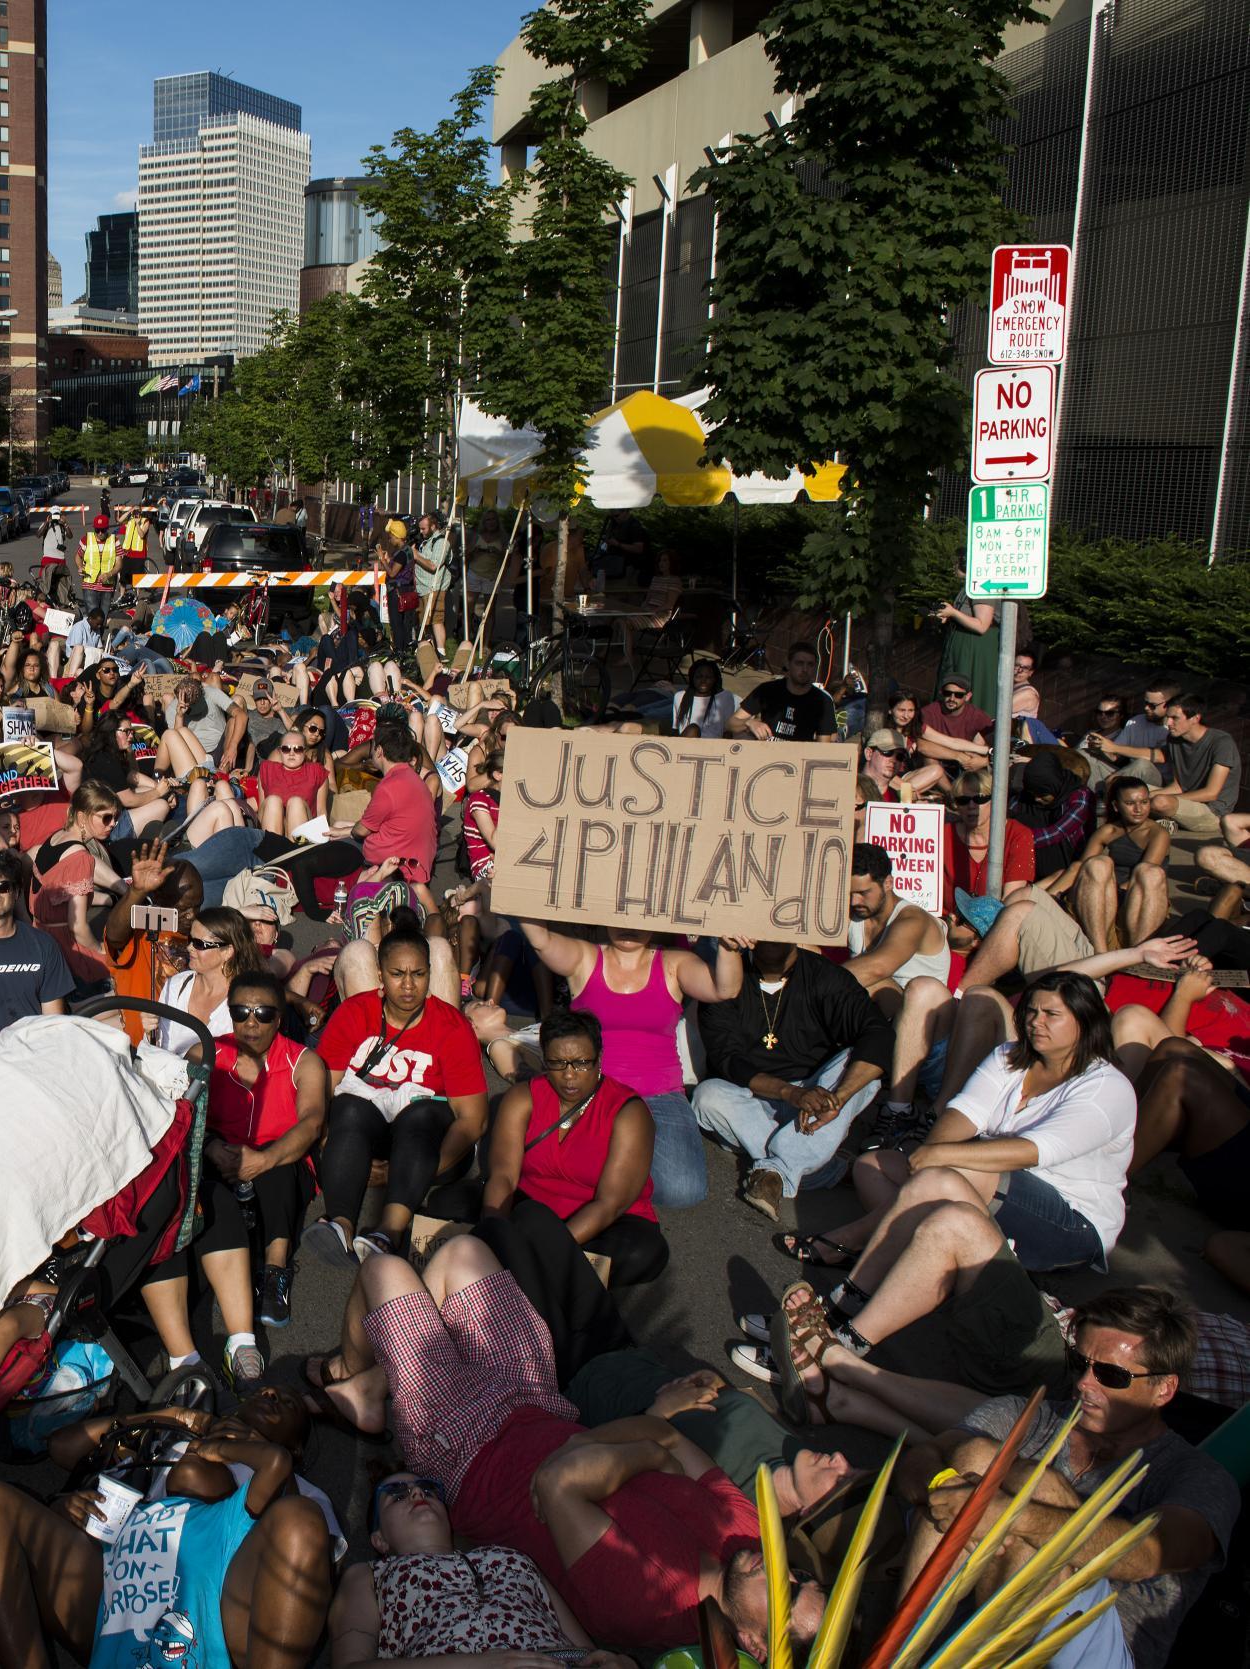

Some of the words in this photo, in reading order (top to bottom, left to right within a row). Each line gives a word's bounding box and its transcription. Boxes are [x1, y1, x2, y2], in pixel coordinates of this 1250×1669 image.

[1013, 300, 1045, 314] SNOW
[996, 316, 1060, 331] EMERGENCY
[1009, 333, 1046, 347] ROUTE
[1000, 349, 1054, 359] 612-348-SNOW
[997, 381, 1032, 410] NO
[979, 416, 1047, 442] PARKING
[979, 490, 988, 518] 1
[1009, 488, 1030, 502] HR
[996, 503, 1043, 518] PARKING
[979, 541, 1002, 551] MON
[1017, 540, 1035, 550] FRI
[986, 553, 1030, 565] EXCEPT
[976, 566, 990, 577] BY
[995, 565, 1038, 577] PERMIT
[889, 813, 916, 834] NO
[871, 835, 935, 854] PARKING
[113, 1560, 147, 1581] ON
